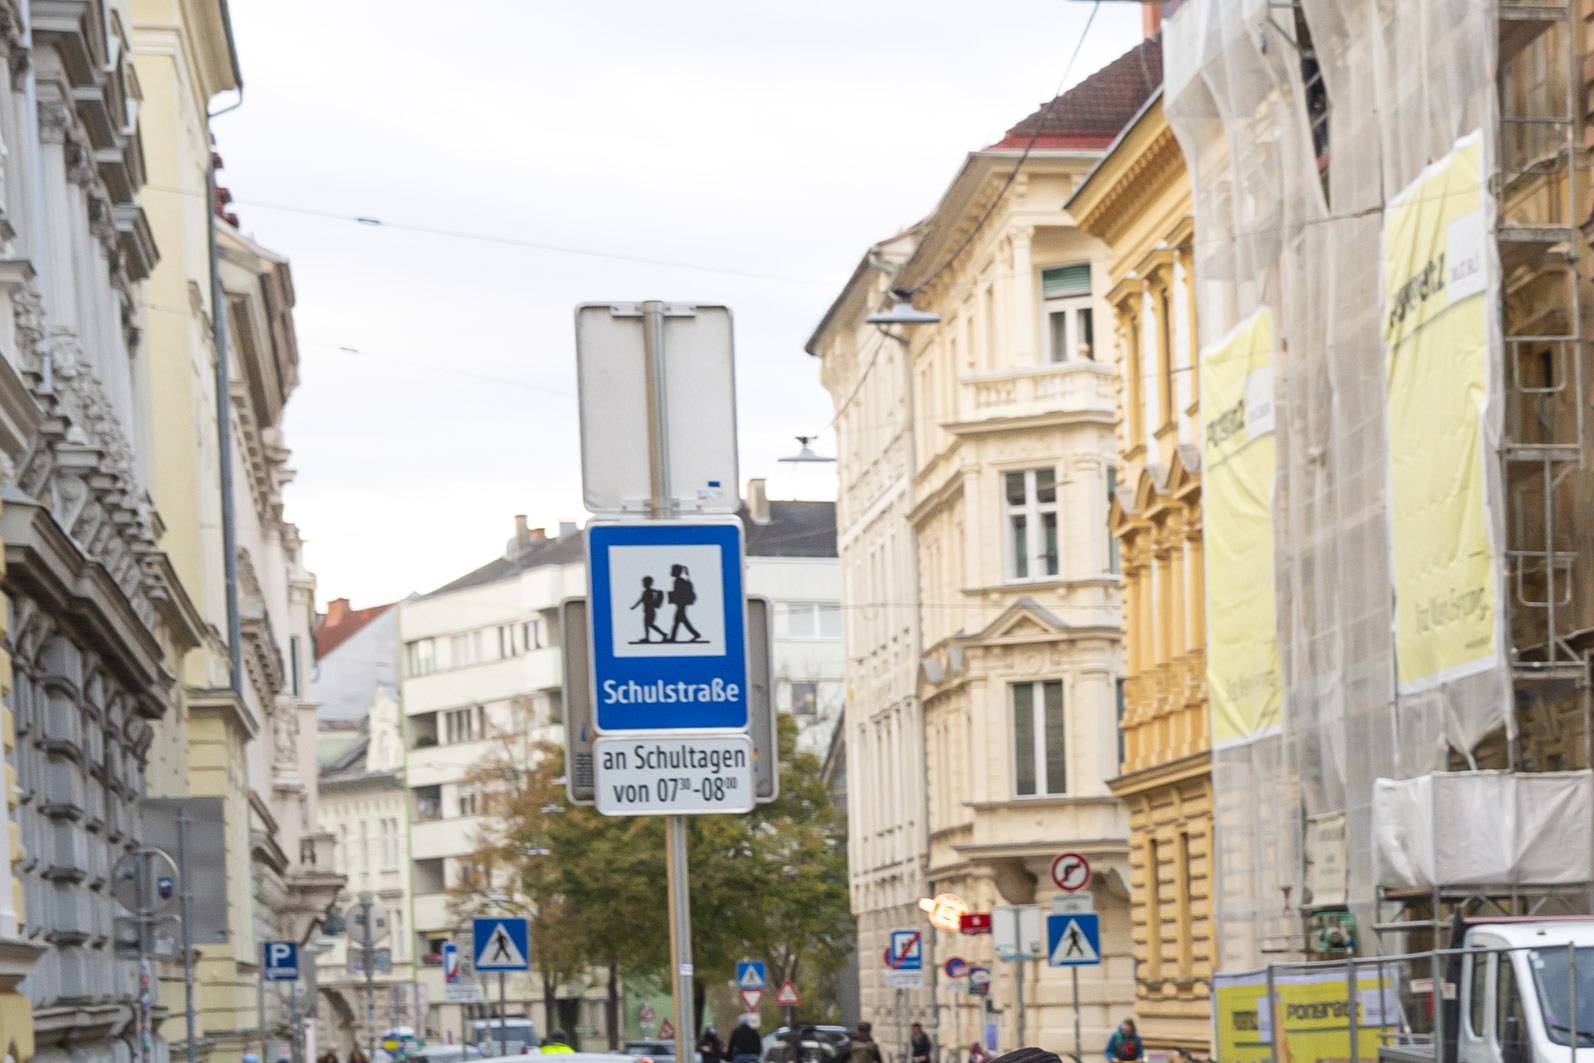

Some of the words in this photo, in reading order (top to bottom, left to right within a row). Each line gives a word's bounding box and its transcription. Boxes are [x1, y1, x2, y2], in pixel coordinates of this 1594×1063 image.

[602, 677, 740, 705] Schulstraße
[602, 751, 628, 770] an
[634, 745, 746, 774] Schultagen
[613, 784, 650, 804] von
[270, 943, 291, 967] P
